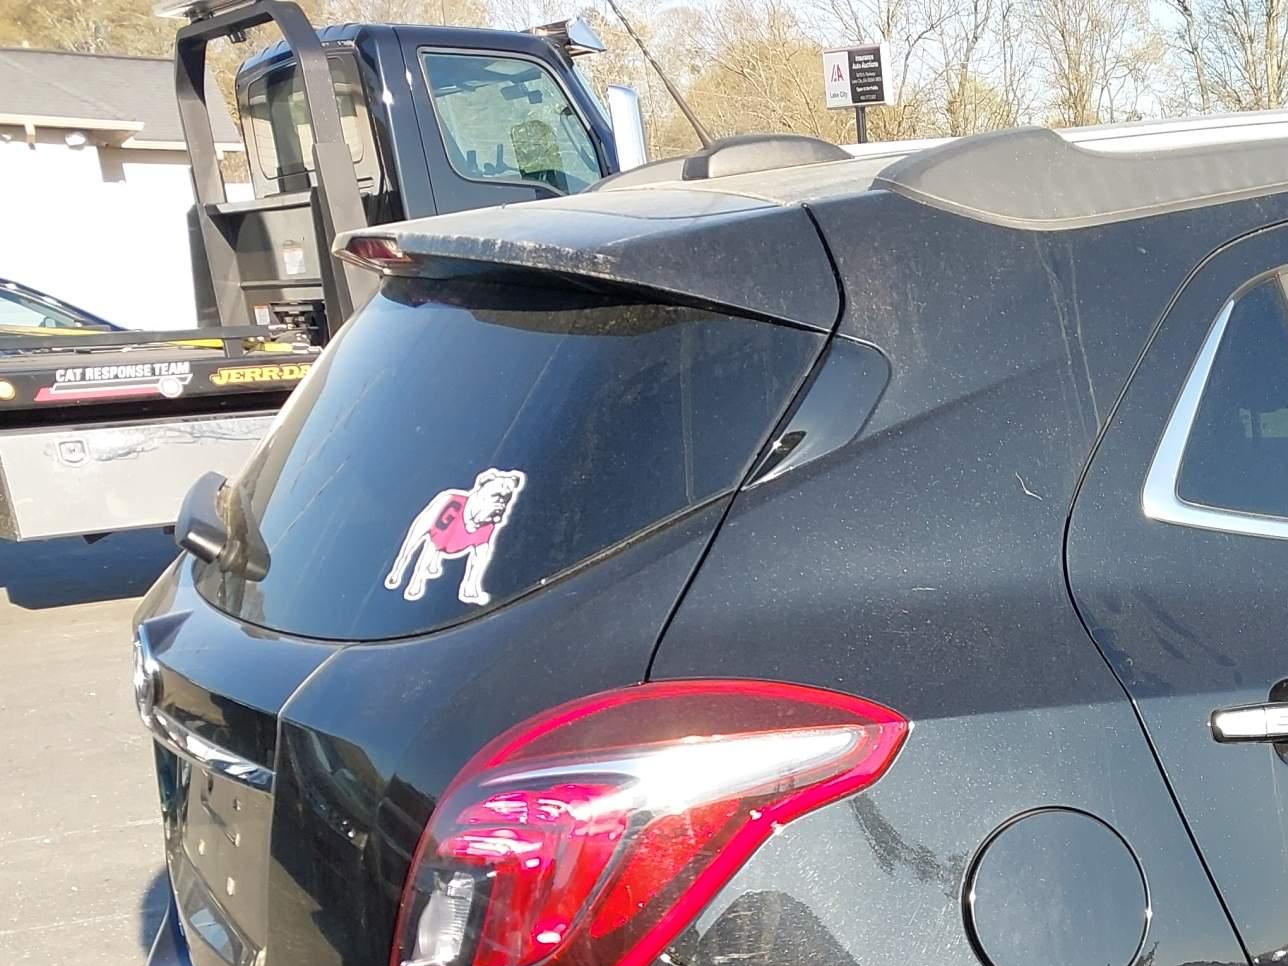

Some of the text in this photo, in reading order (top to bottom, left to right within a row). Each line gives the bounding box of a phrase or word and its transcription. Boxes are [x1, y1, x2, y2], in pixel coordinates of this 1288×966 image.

[55, 361, 191, 382] CAT RESPONSE TEAM
[434, 500, 463, 531] G
